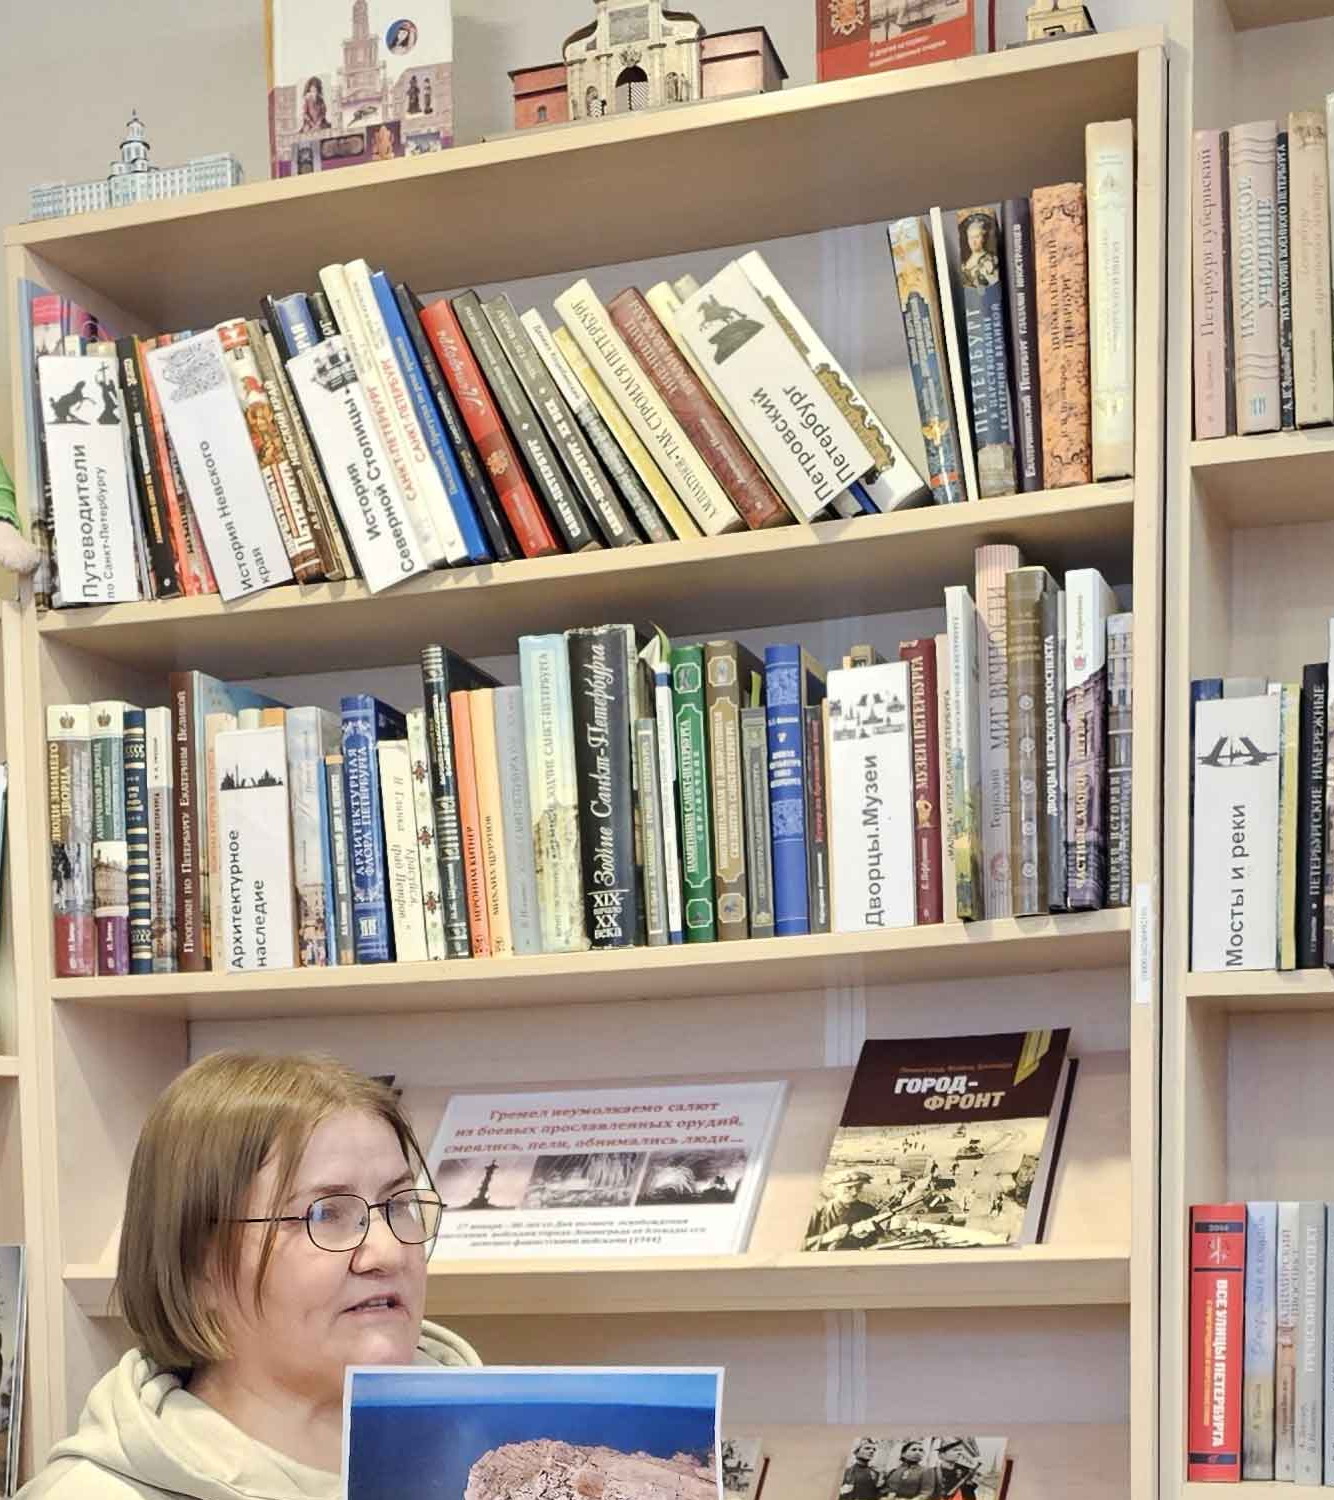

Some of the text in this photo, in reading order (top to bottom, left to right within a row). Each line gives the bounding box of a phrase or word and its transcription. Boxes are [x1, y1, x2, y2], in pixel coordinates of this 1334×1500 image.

[1195, 147, 1220, 337] Петербург губернский
[1238, 178, 1256, 339] НАХИМОВСКОЕ
[1256, 198, 1276, 308] УЧИЛИЩЕ
[966, 307, 989, 434] ПЕТЕРБУРГ
[990, 303, 1009, 430] ЕКАТЕРИНЫ ВЕЛИКОЙ
[345, 395, 416, 574] Северной Столицы
[749, 386, 835, 502] Петровский
[782, 384, 856, 484] Петербург
[71, 444, 101, 598] Путеводители
[93, 466, 117, 599] по Санкт-Петербургу
[197, 439, 255, 592] История Невского
[251, 546, 272, 587] края
[344, 461, 382, 543] История
[585, 643, 614, 818] Санкт-Петербурга
[911, 655, 928, 790] МУЗЕИ ПЕТЕРБУРГА
[987, 585, 1009, 751] МИГ ВЕЧНОСТИ
[347, 747, 365, 877] АРХИТЕКТУРНАЯ
[862, 754, 886, 927] Дворцы.Музеи
[1309, 683, 1326, 896] ПЕТЕРБУРГСКИЕ НАБЕРЕЖНЫЕ
[226, 829, 245, 969] Архитектурное
[252, 879, 268, 968] наследие
[1225, 803, 1249, 967] Мосты и реки
[443, 1140, 526, 1155] смеялись,
[528, 1139, 570, 1153] пели,
[576, 1135, 679, 1152] обнимались
[478, 1122, 535, 1137] боевых
[541, 1118, 673, 1137] прославленных
[676, 1114, 745, 1133] орудий,
[489, 1100, 722, 1122] Гремел неумолкаемо салют
[894, 1074, 979, 1095] ГОРОД-
[923, 1091, 1006, 1111] ФРОНТ
